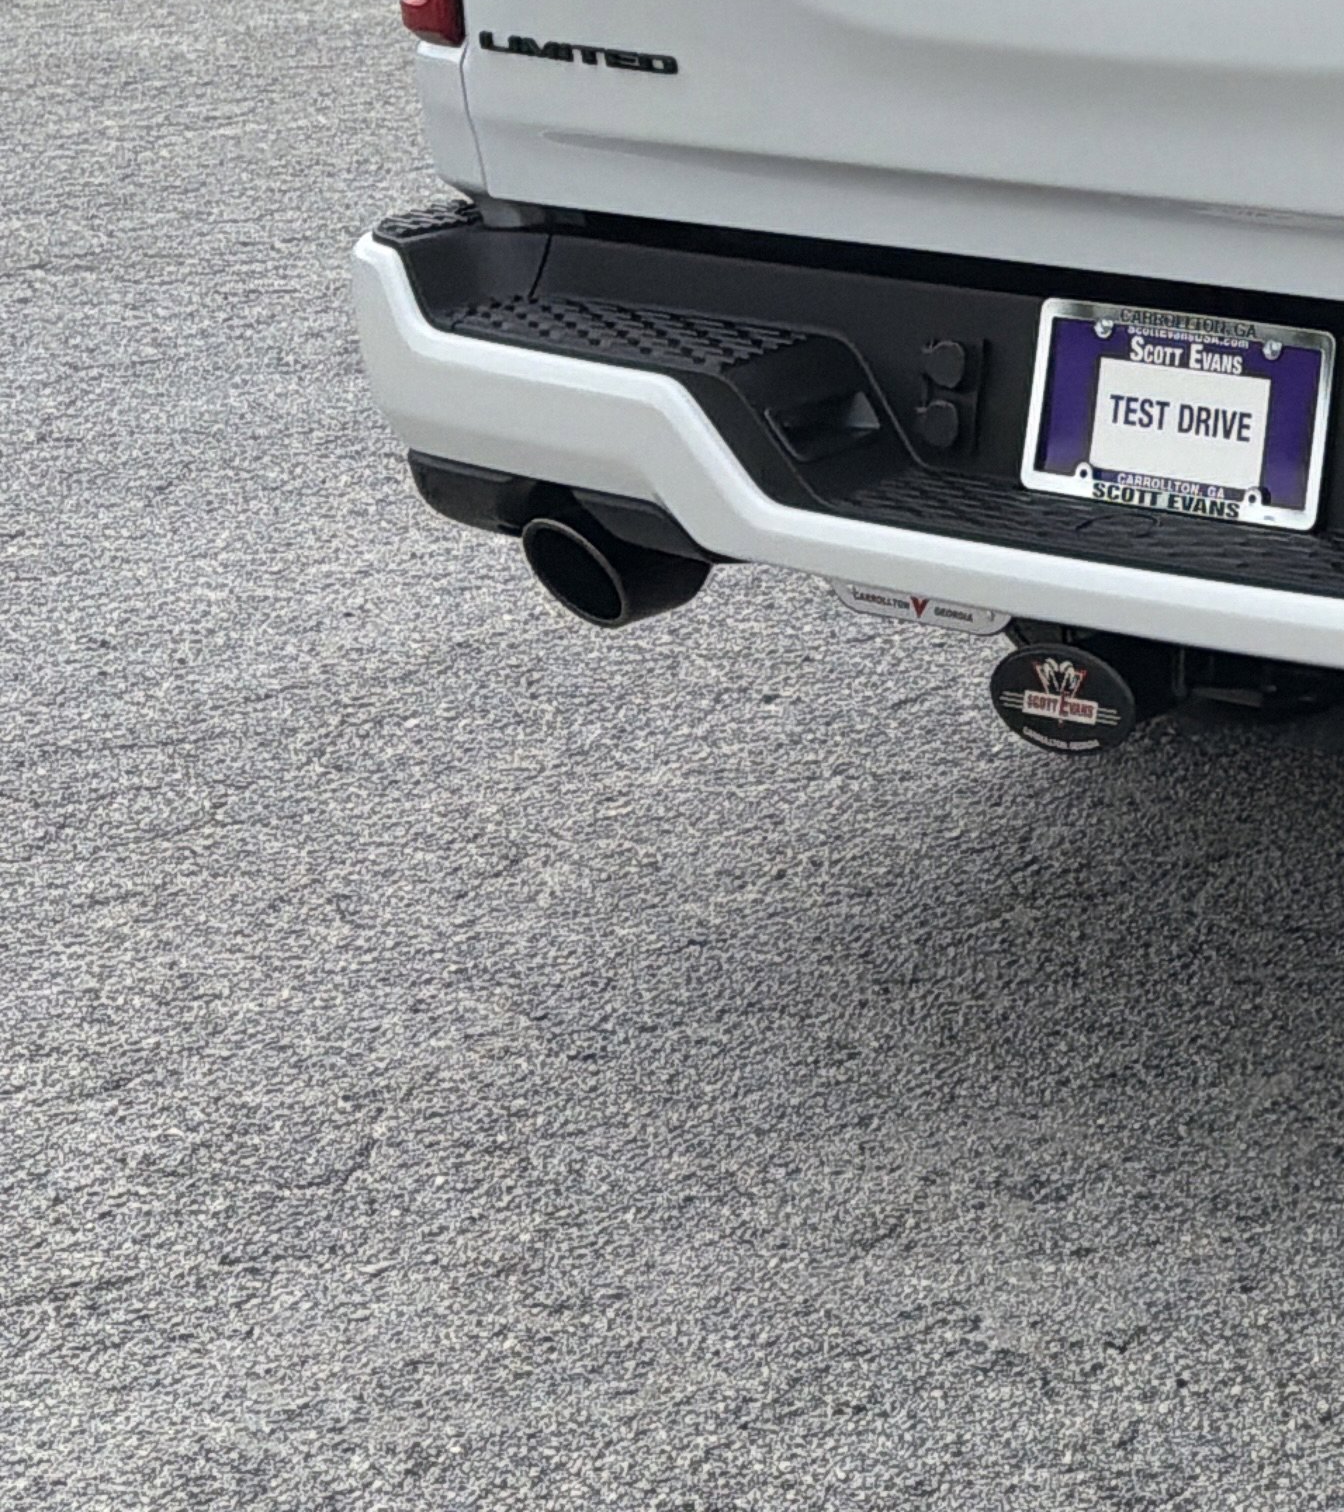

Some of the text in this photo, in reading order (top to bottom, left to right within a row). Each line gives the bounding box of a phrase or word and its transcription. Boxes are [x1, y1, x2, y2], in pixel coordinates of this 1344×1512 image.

[479, 30, 678, 75] LIMITED
[1234, 323, 1257, 339] GA
[1109, 394, 1253, 442] TEST DRIVE
[1092, 482, 1240, 519] SCOTT EVANS
[1207, 486, 1225, 499] GA
[853, 590, 974, 623] CARROLLTON GEORGIA
[1027, 694, 1058, 713] SCOTT
